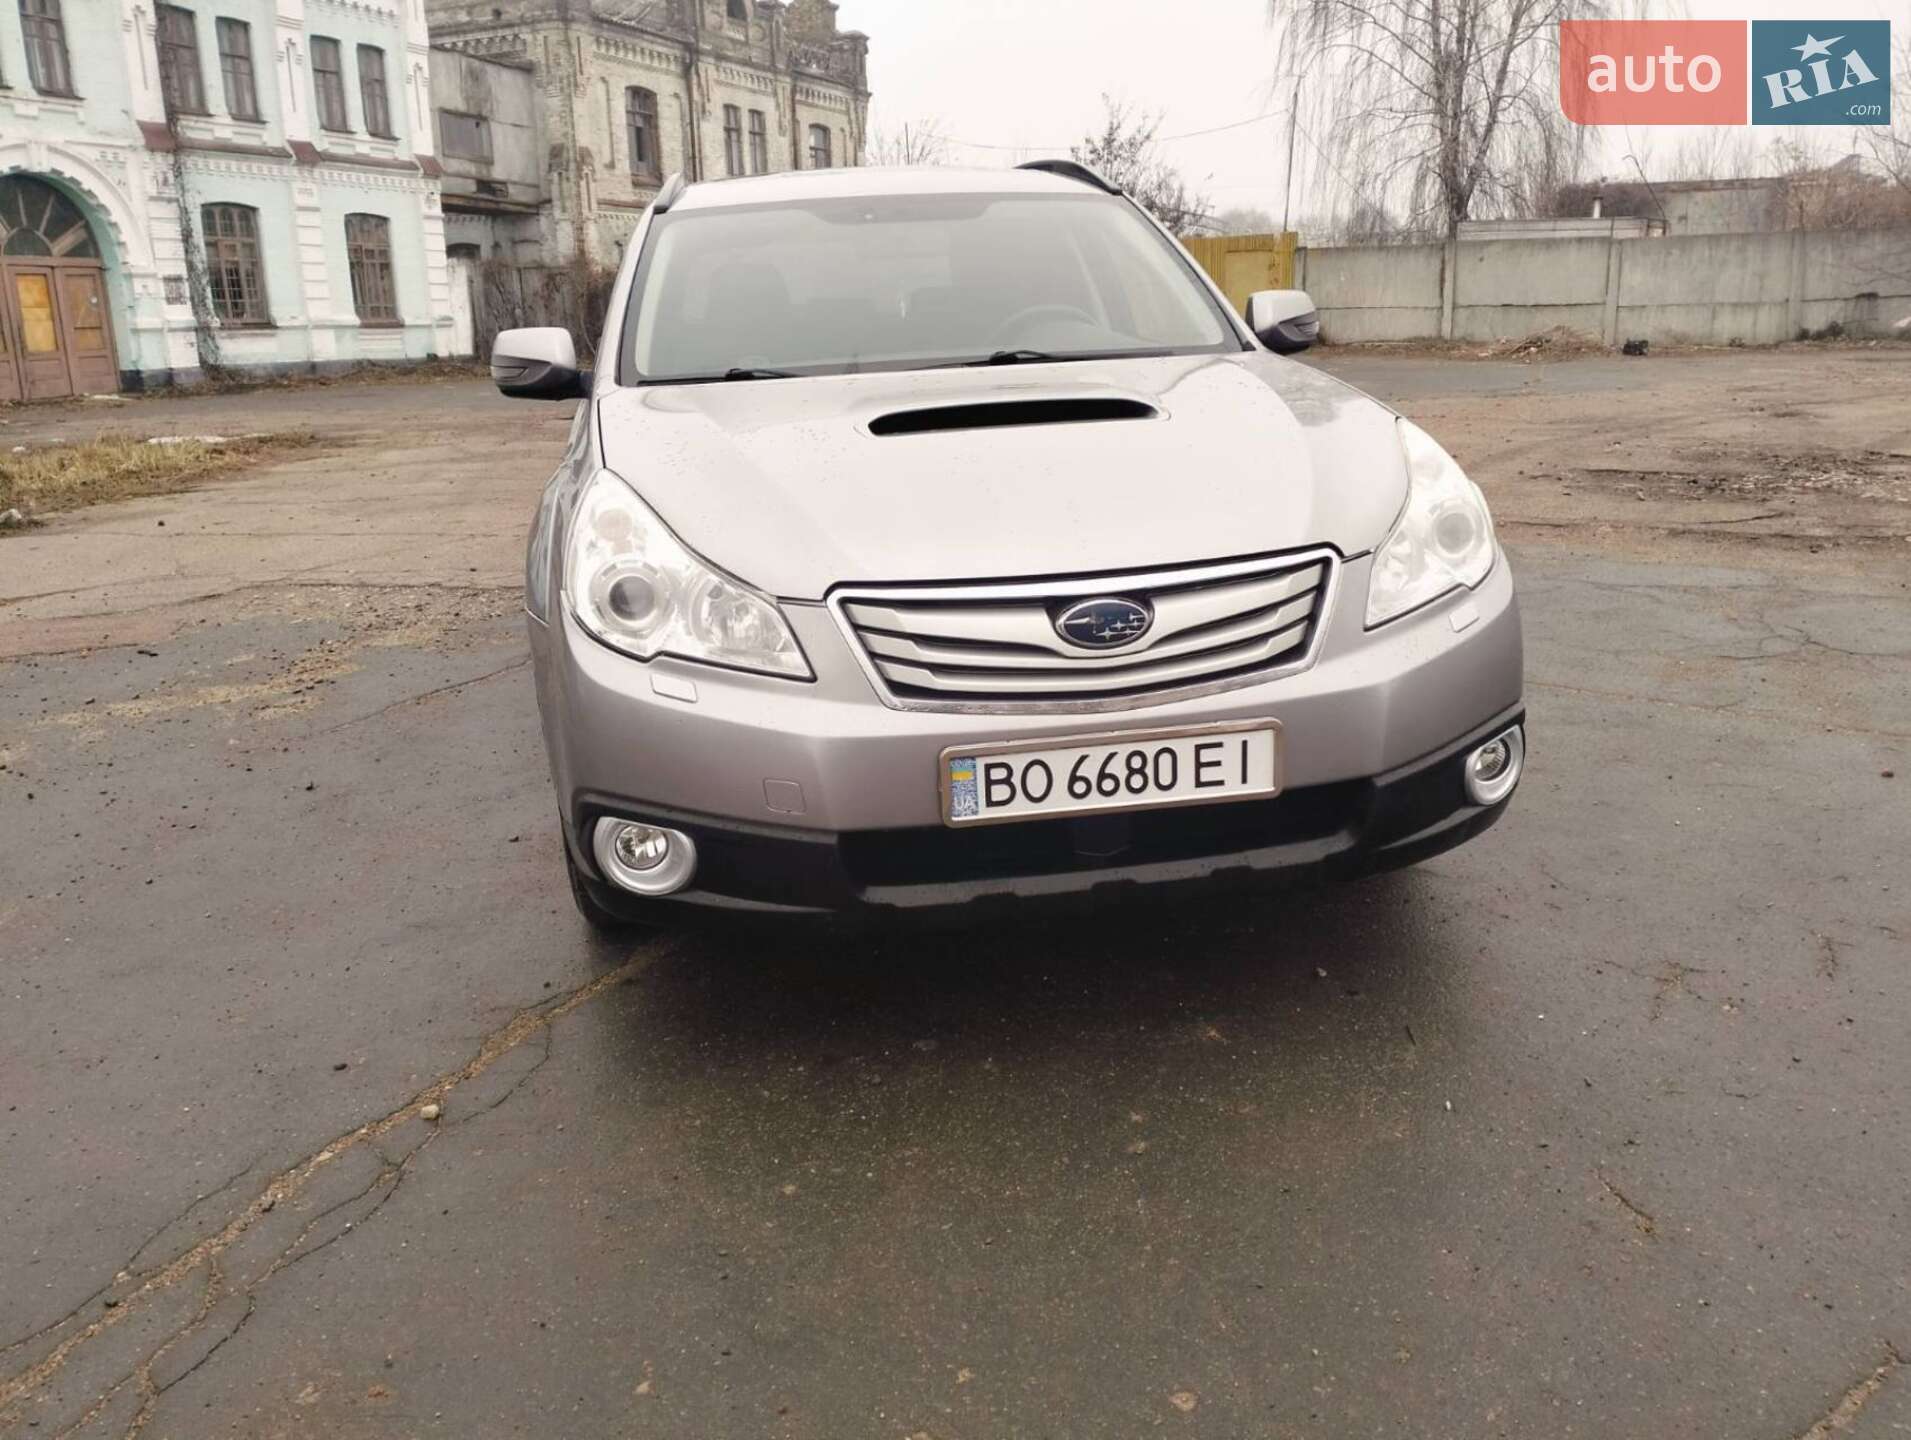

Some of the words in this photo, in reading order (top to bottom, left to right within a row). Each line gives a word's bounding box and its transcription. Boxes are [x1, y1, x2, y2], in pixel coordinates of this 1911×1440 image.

[984, 759, 1053, 807] BO
[1067, 747, 1178, 799] 6680
[1194, 739, 1249, 788] EI
[954, 794, 977, 810] UA
